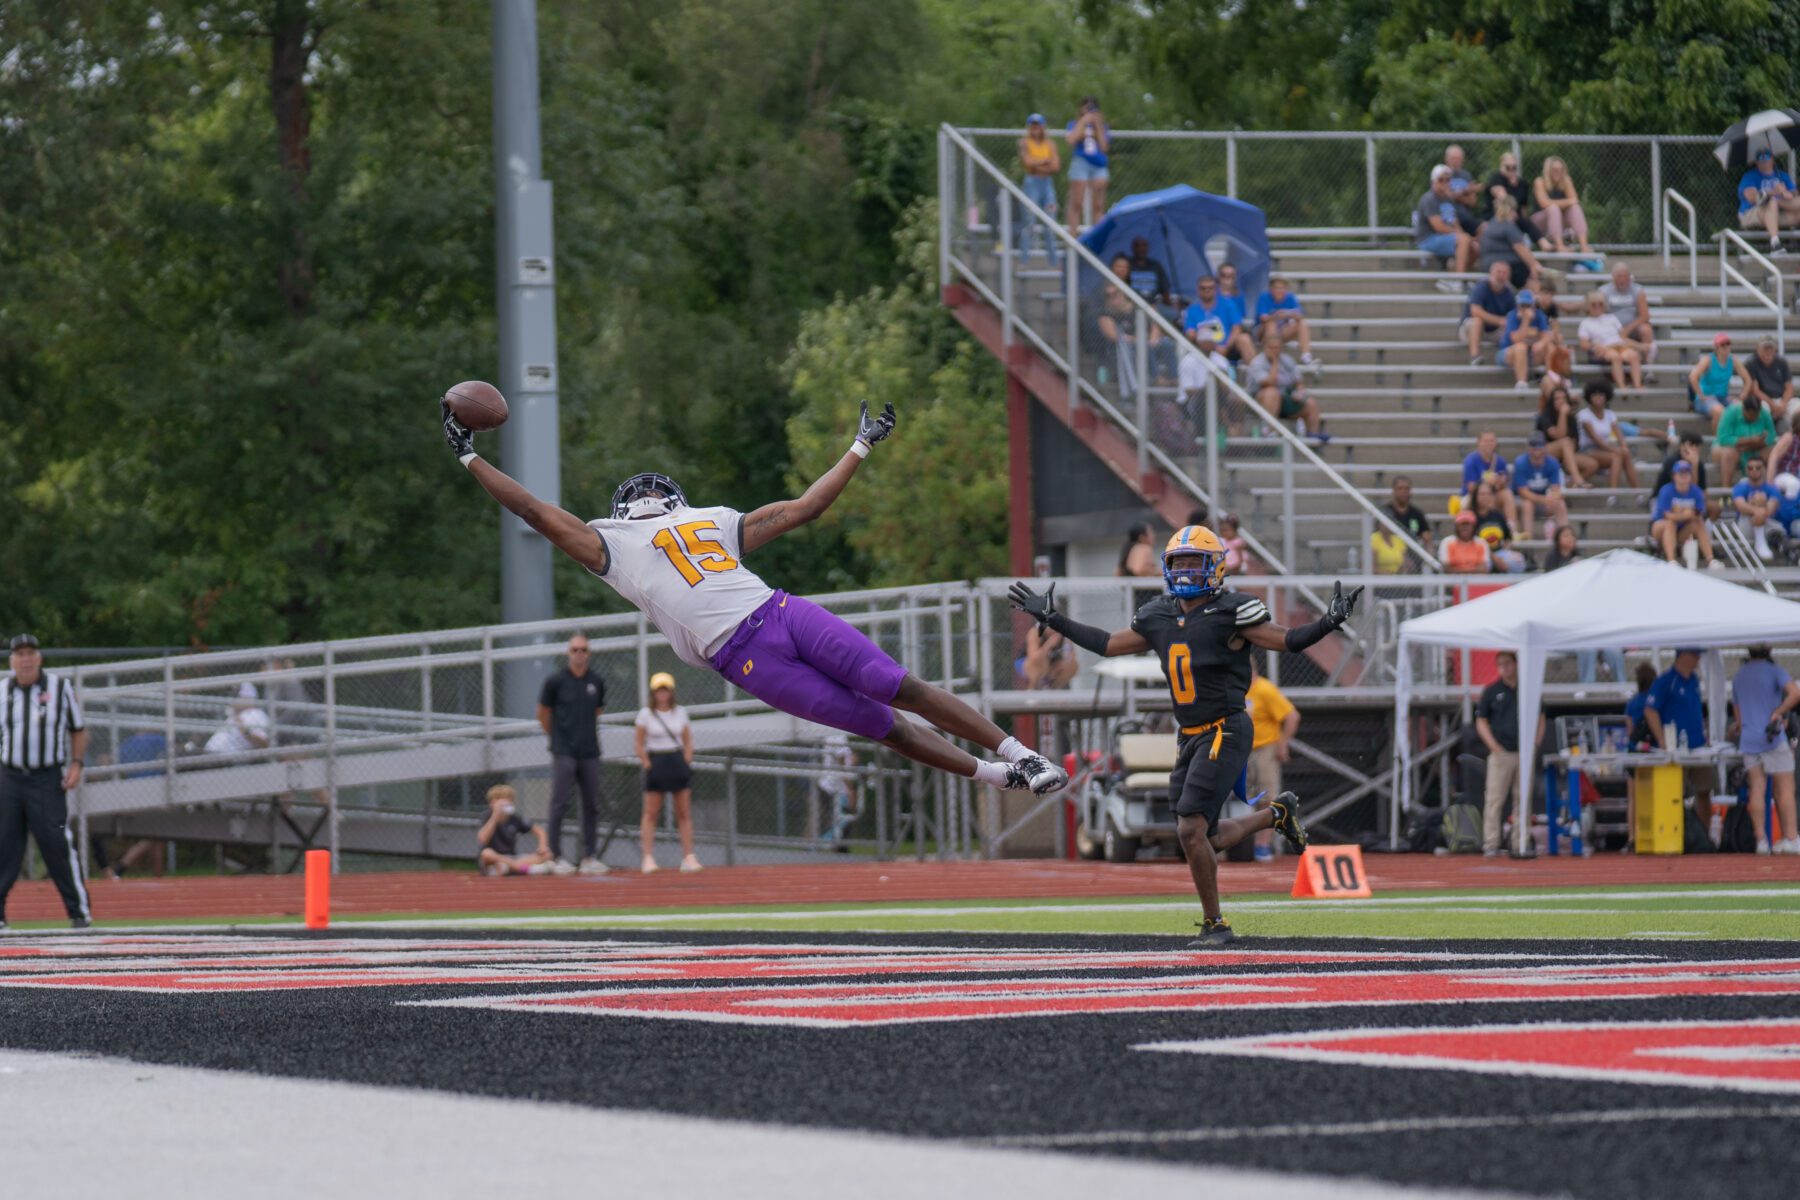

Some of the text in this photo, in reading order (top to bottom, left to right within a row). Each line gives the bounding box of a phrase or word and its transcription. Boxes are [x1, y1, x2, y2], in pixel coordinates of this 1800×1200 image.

[651, 519, 738, 588] 15
[1168, 641, 1196, 705] 0
[1314, 854, 1360, 891] 10
